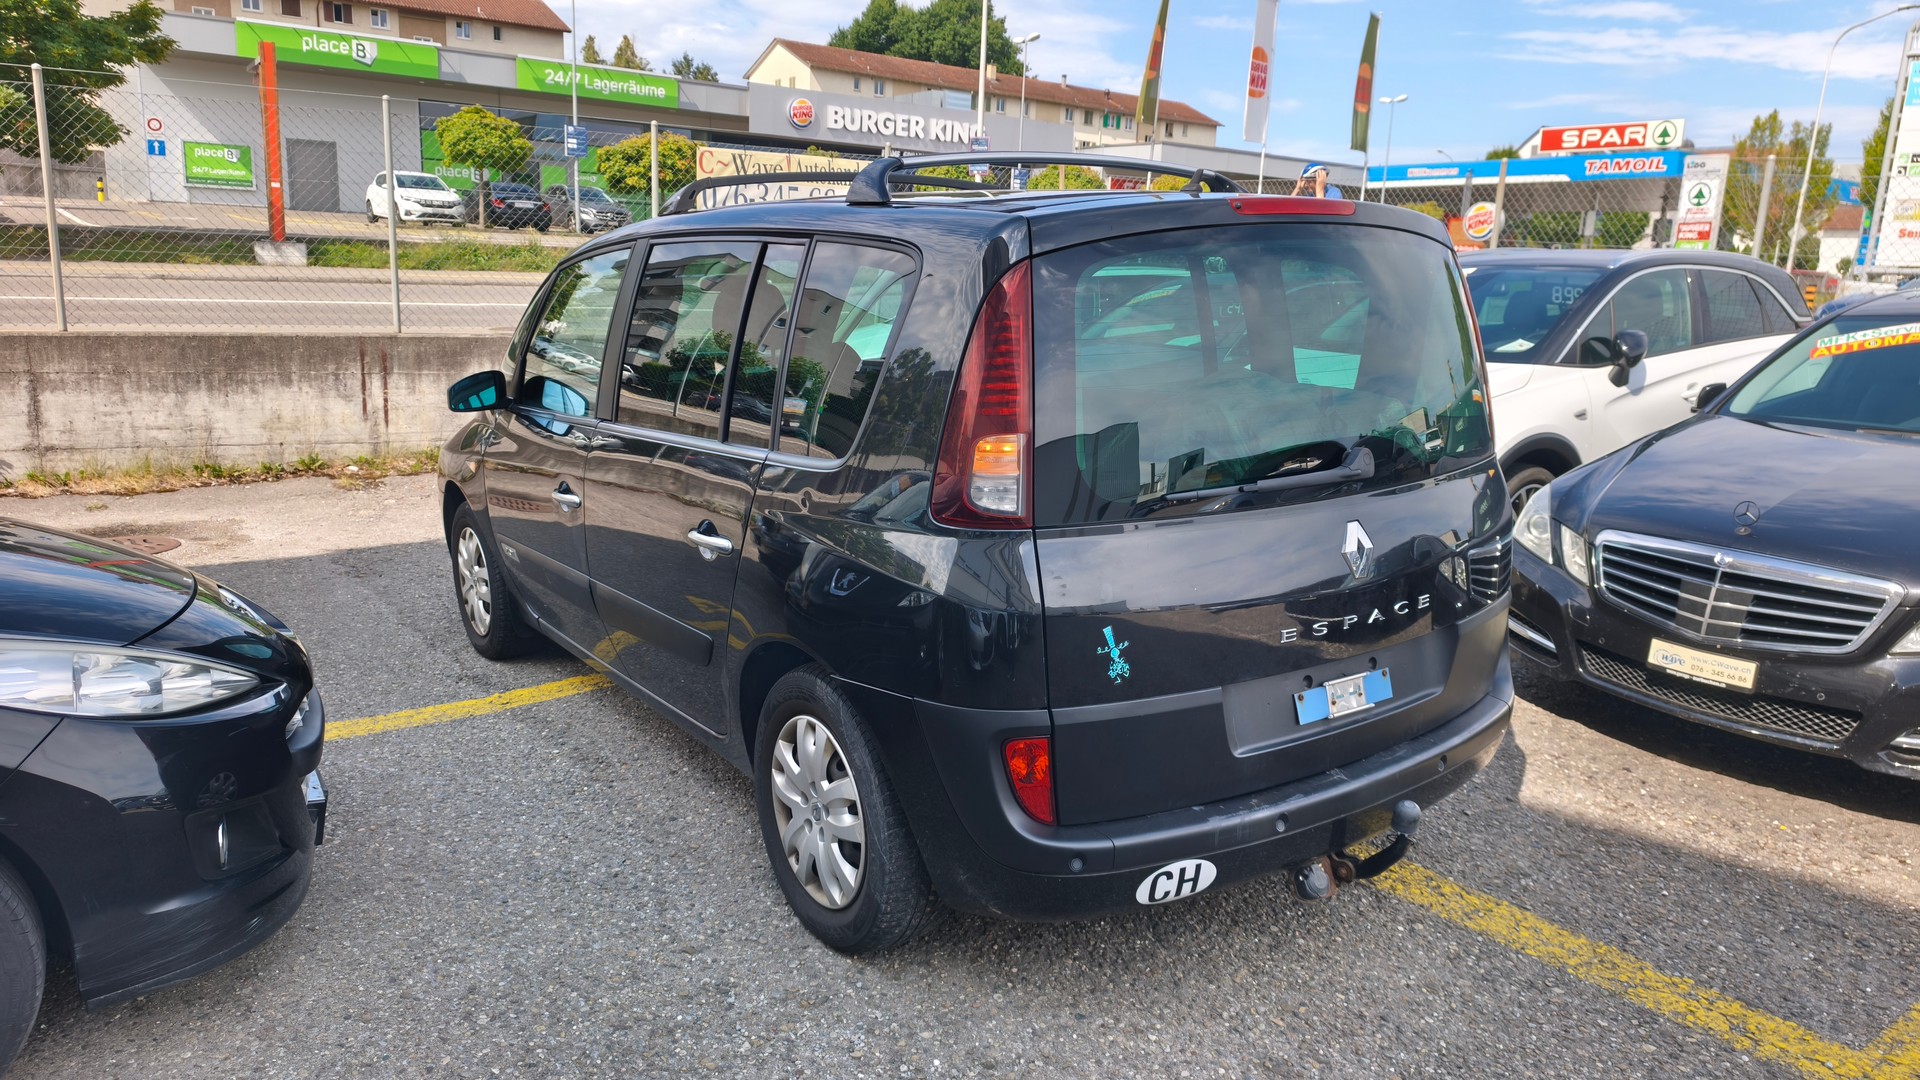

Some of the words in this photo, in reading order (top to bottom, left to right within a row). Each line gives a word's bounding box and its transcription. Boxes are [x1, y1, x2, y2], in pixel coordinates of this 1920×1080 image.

[302, 34, 350, 54] place
[544, 68, 581, 86] 24/7
[584, 74, 666, 98] Lagerräume
[826, 104, 925, 139] BURGER
[1561, 126, 1646, 148] SPAR
[194, 147, 224, 158] place
[1585, 156, 1667, 175] TAMOIL
[1467, 215, 1494, 231] KING
[1280, 594, 1431, 644] ESPACE
[1148, 863, 1202, 903] CH
